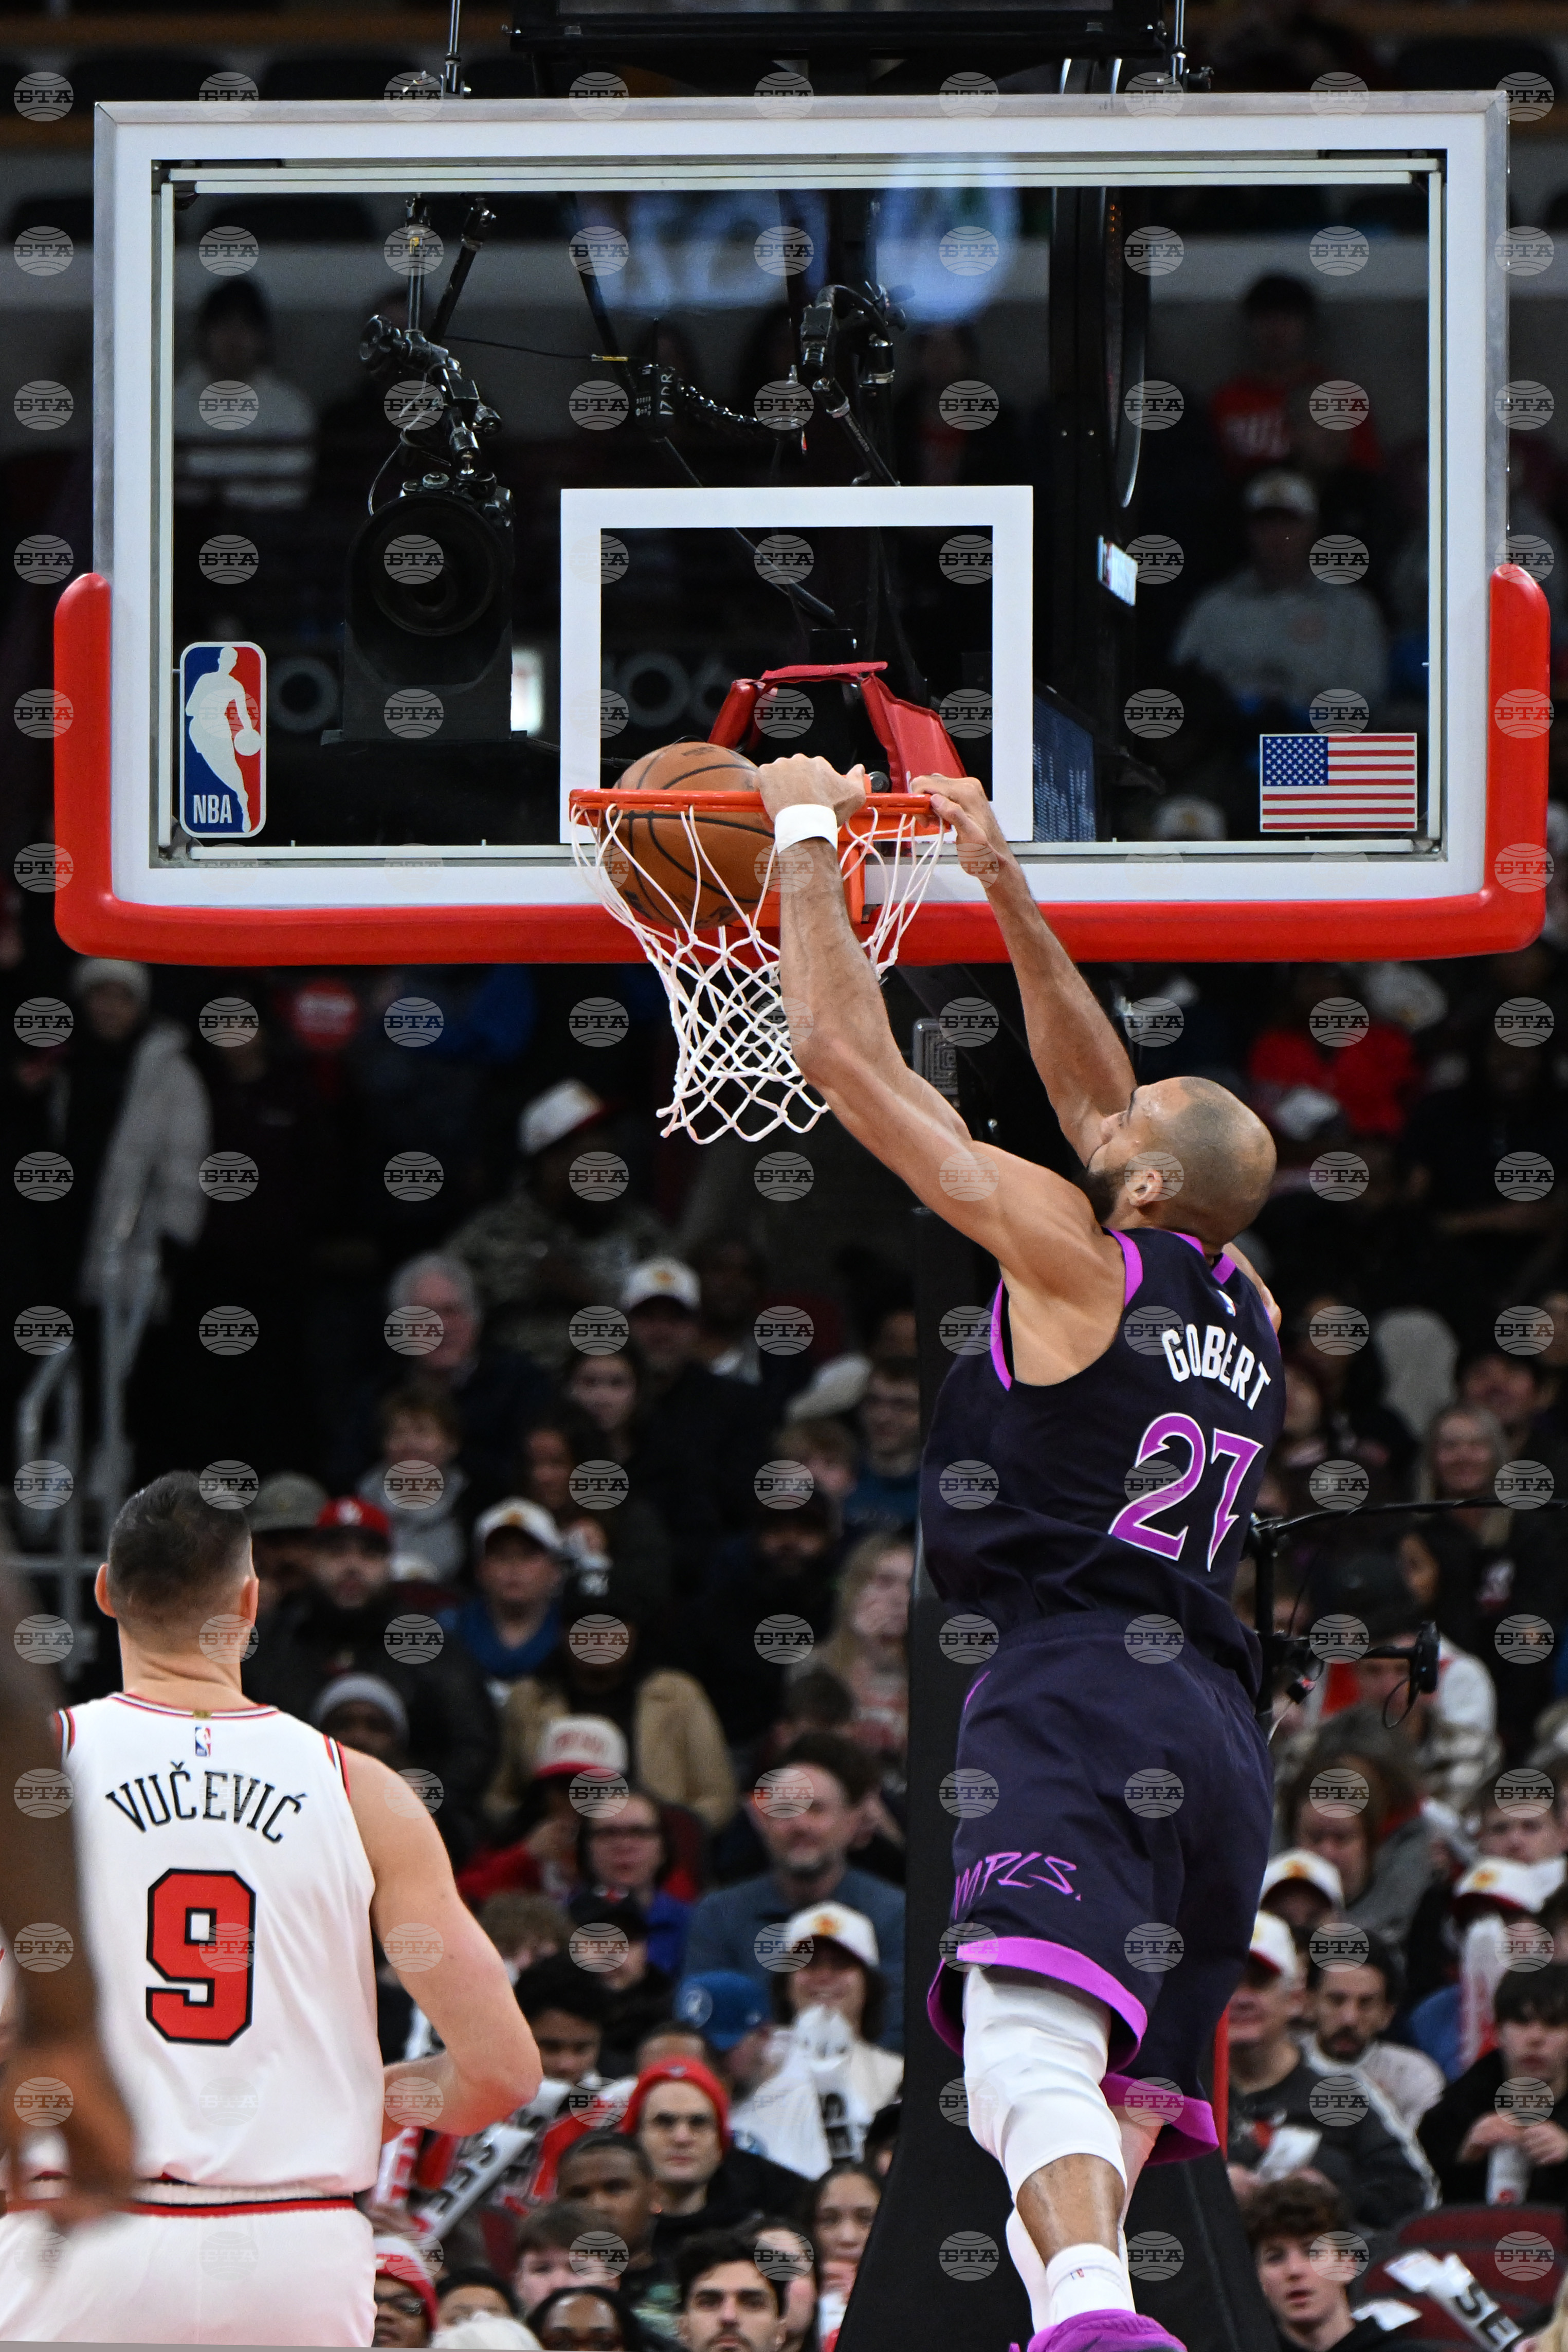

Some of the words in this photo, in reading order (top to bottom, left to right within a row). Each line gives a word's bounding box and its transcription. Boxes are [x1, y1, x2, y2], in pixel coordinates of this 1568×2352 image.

[193, 794, 232, 824] NBA
[1161, 1323, 1271, 1410] GOBERT
[1107, 1412, 1264, 1572] 27
[104, 1760, 308, 1845] VUČEVIĆ
[145, 1867, 257, 2047] 9
